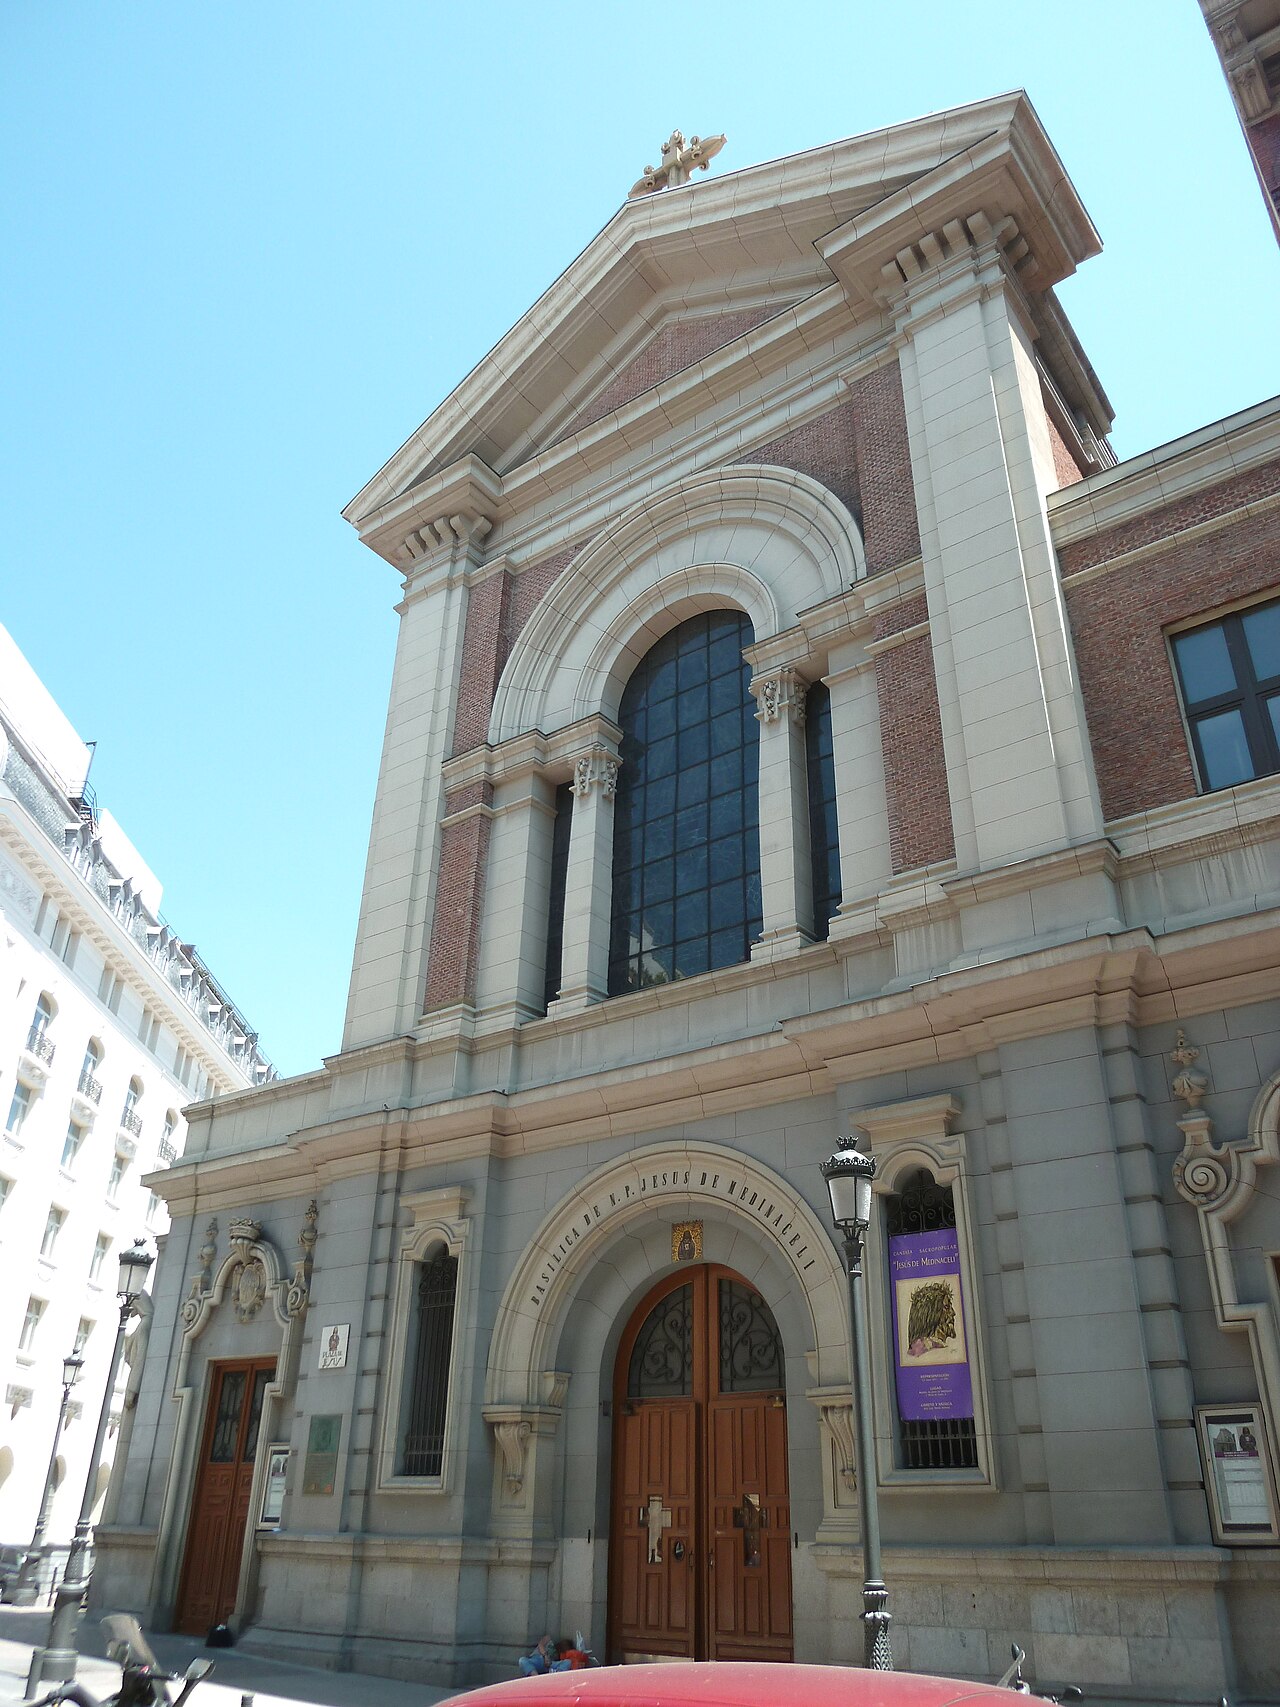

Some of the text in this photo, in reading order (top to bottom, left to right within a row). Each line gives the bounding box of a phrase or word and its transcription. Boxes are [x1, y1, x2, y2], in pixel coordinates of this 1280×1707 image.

[531, 1171, 815, 1305] BASILICA DE N. P. JESUS DE MEDINACELI
